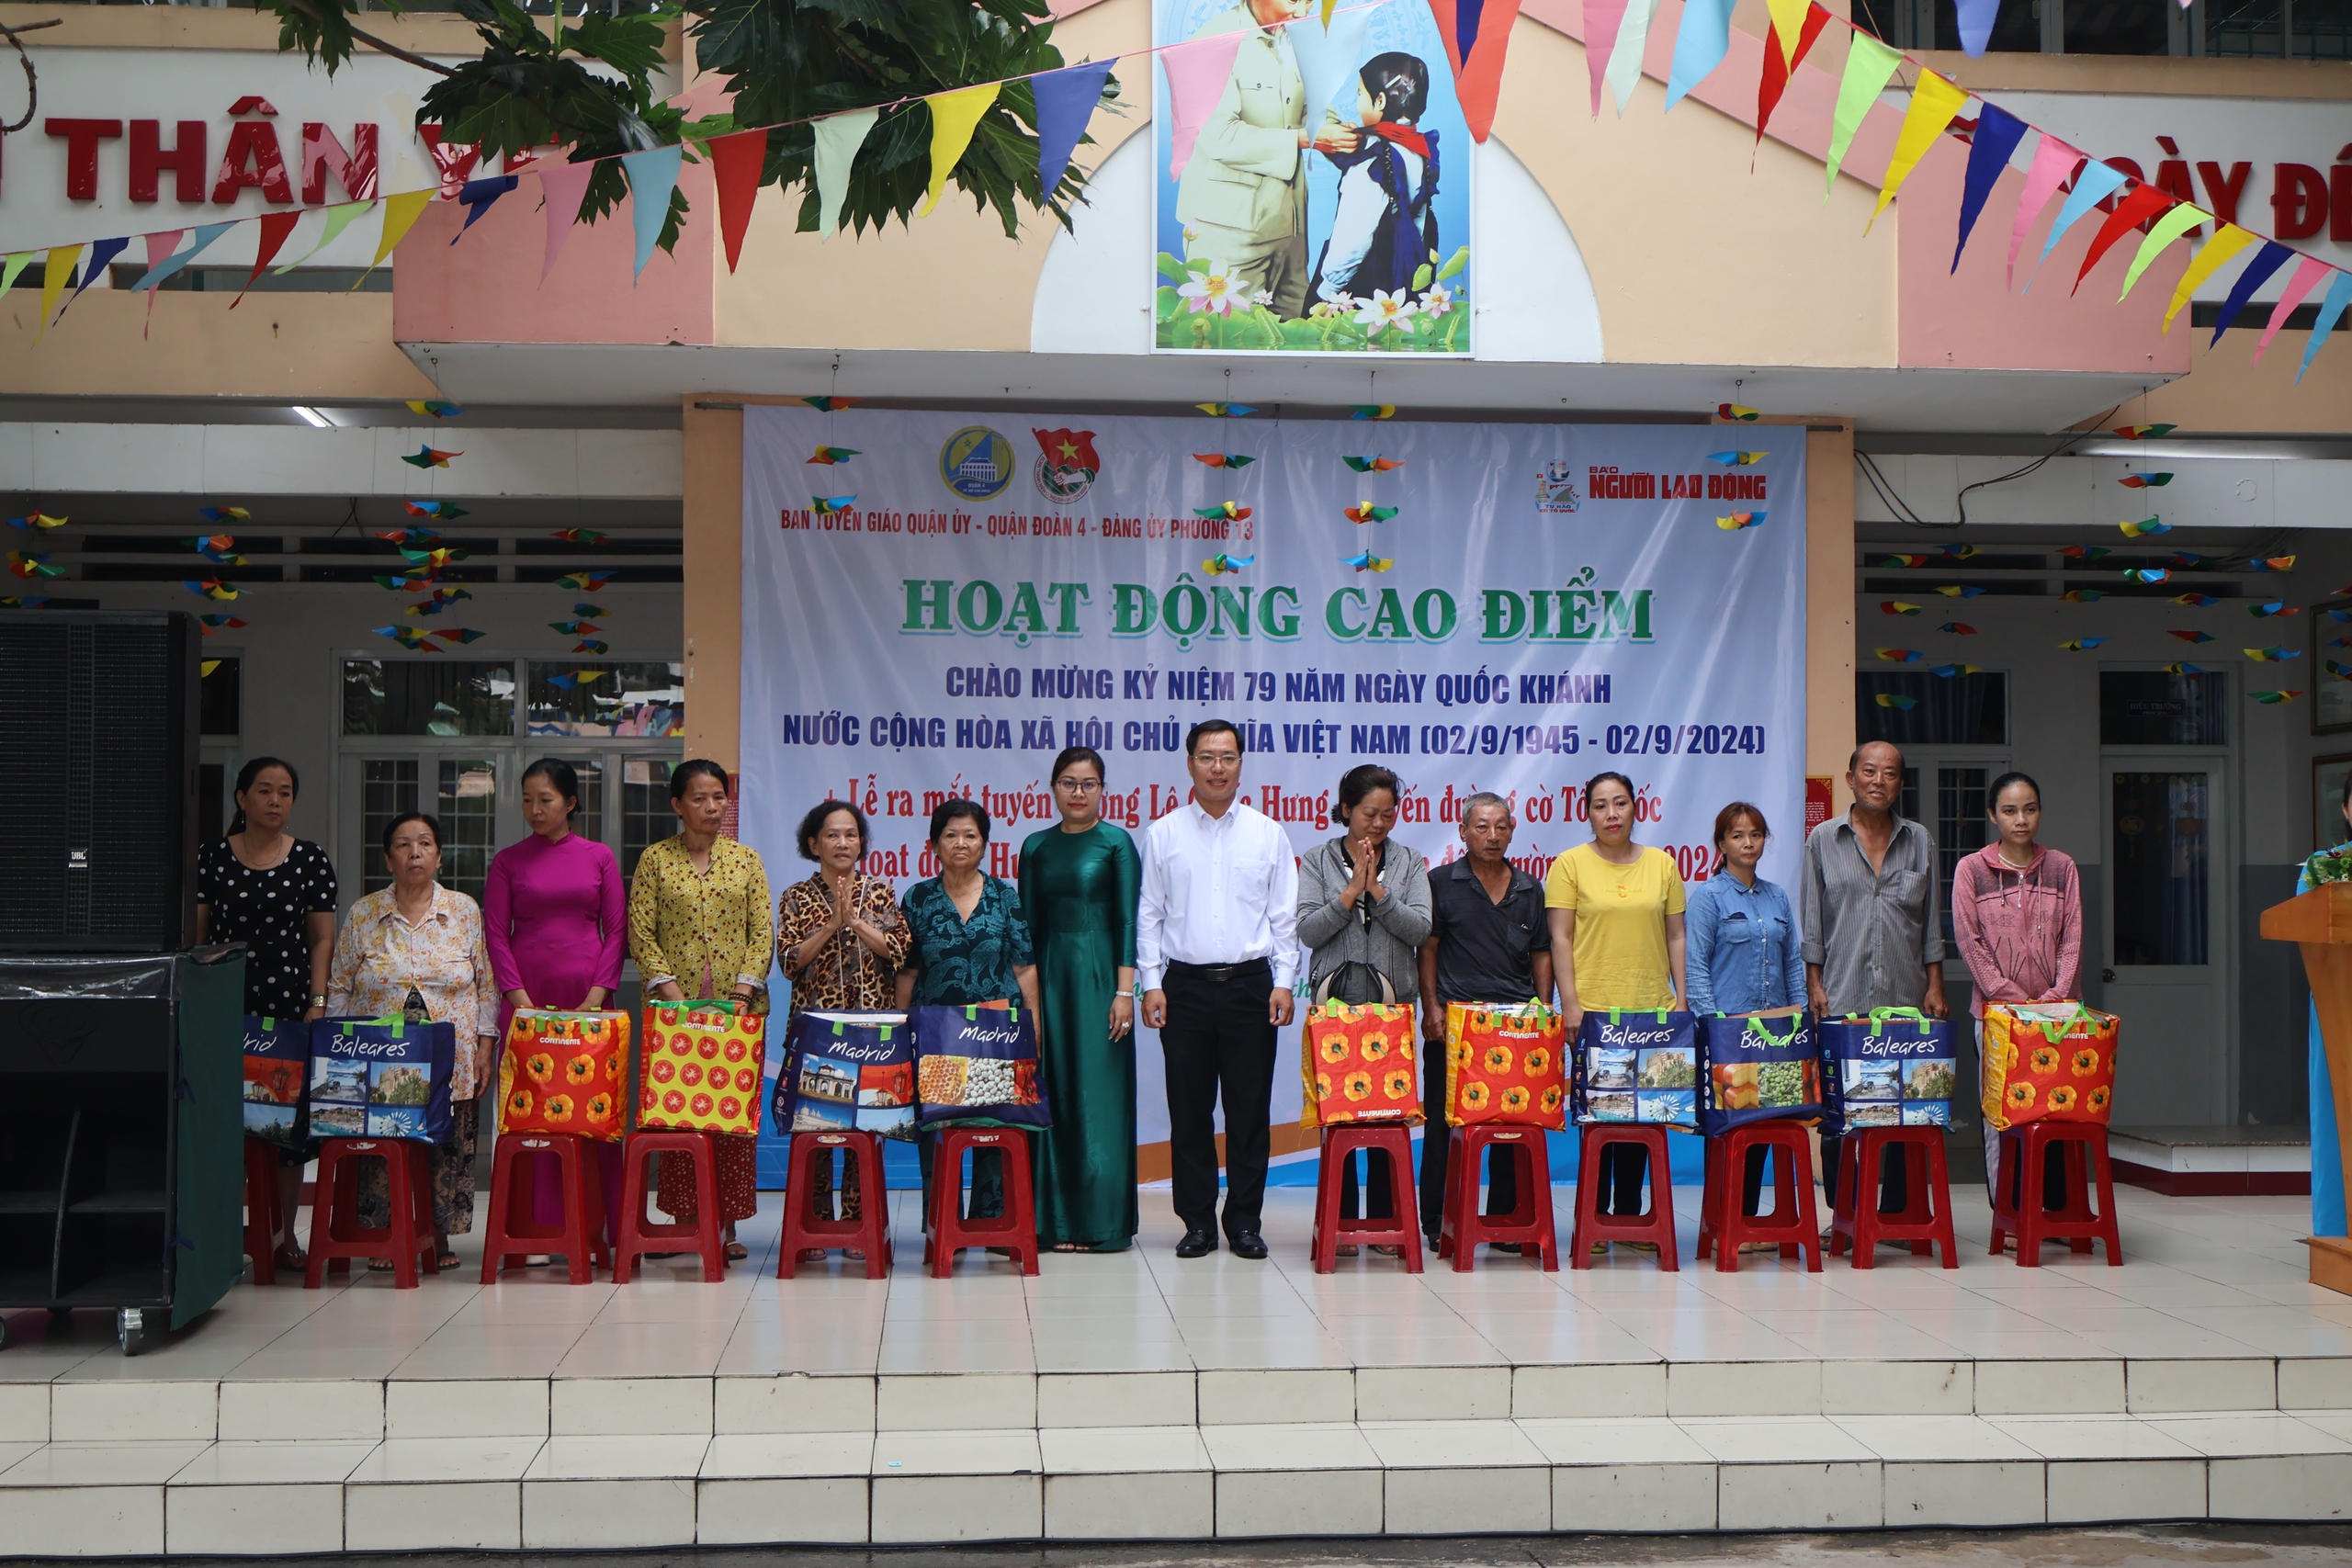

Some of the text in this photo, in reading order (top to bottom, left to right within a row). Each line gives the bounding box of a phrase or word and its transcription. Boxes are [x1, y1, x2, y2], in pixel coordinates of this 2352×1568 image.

[44, 96, 379, 205] THÂN
[1589, 471, 1766, 502] NGƯỜI LAO ĐỘNG
[781, 510, 810, 529] BAN
[866, 508, 902, 533] GIÁO
[907, 509, 947, 537] QUẬN
[953, 508, 972, 534] ỦY
[988, 511, 1027, 540] QUẬN
[1032, 512, 1072, 536] ĐOÀN
[1077, 517, 1086, 536] 4
[1102, 513, 1141, 538] ĐẢNG
[1147, 513, 1166, 538] ỦY
[1235, 520, 1253, 540] 13
[901, 566, 1653, 648] HOẠT ĐỘNG CAO ĐIỂM
[945, 663, 1611, 707] CHÀO MỪNG KỶ NIỆM 79 NĂM NGÀY QUỐC KHÁNH
[783, 710, 860, 746] NƯỚC
[869, 712, 945, 752] CỘNG
[956, 714, 1012, 750] HÒA
[1021, 716, 1056, 750] XÃ
[1123, 716, 1180, 751] CHỦ
[1283, 719, 1341, 759] VIỆT
[1351, 725, 1411, 754] NAM
[848, 773, 878, 816] Lễ
[887, 789, 914, 817] ra
[981, 780, 1053, 827] tuyến
[1149, 784, 1179, 820] Lê
[1261, 784, 1330, 831] Hưng
[1525, 784, 1554, 823] cờ
[244, 1032, 277, 1053] rid
[330, 1033, 411, 1058] Baleares
[539, 1036, 582, 1045] CONTINENTE
[958, 1025, 1021, 1044] Madrid
[1498, 1030, 1540, 1040] CONTINENTE
[1600, 1023, 1675, 1054] Baleares
[1861, 1035, 1939, 1057] Baleares
[828, 1040, 897, 1062] Madrid
